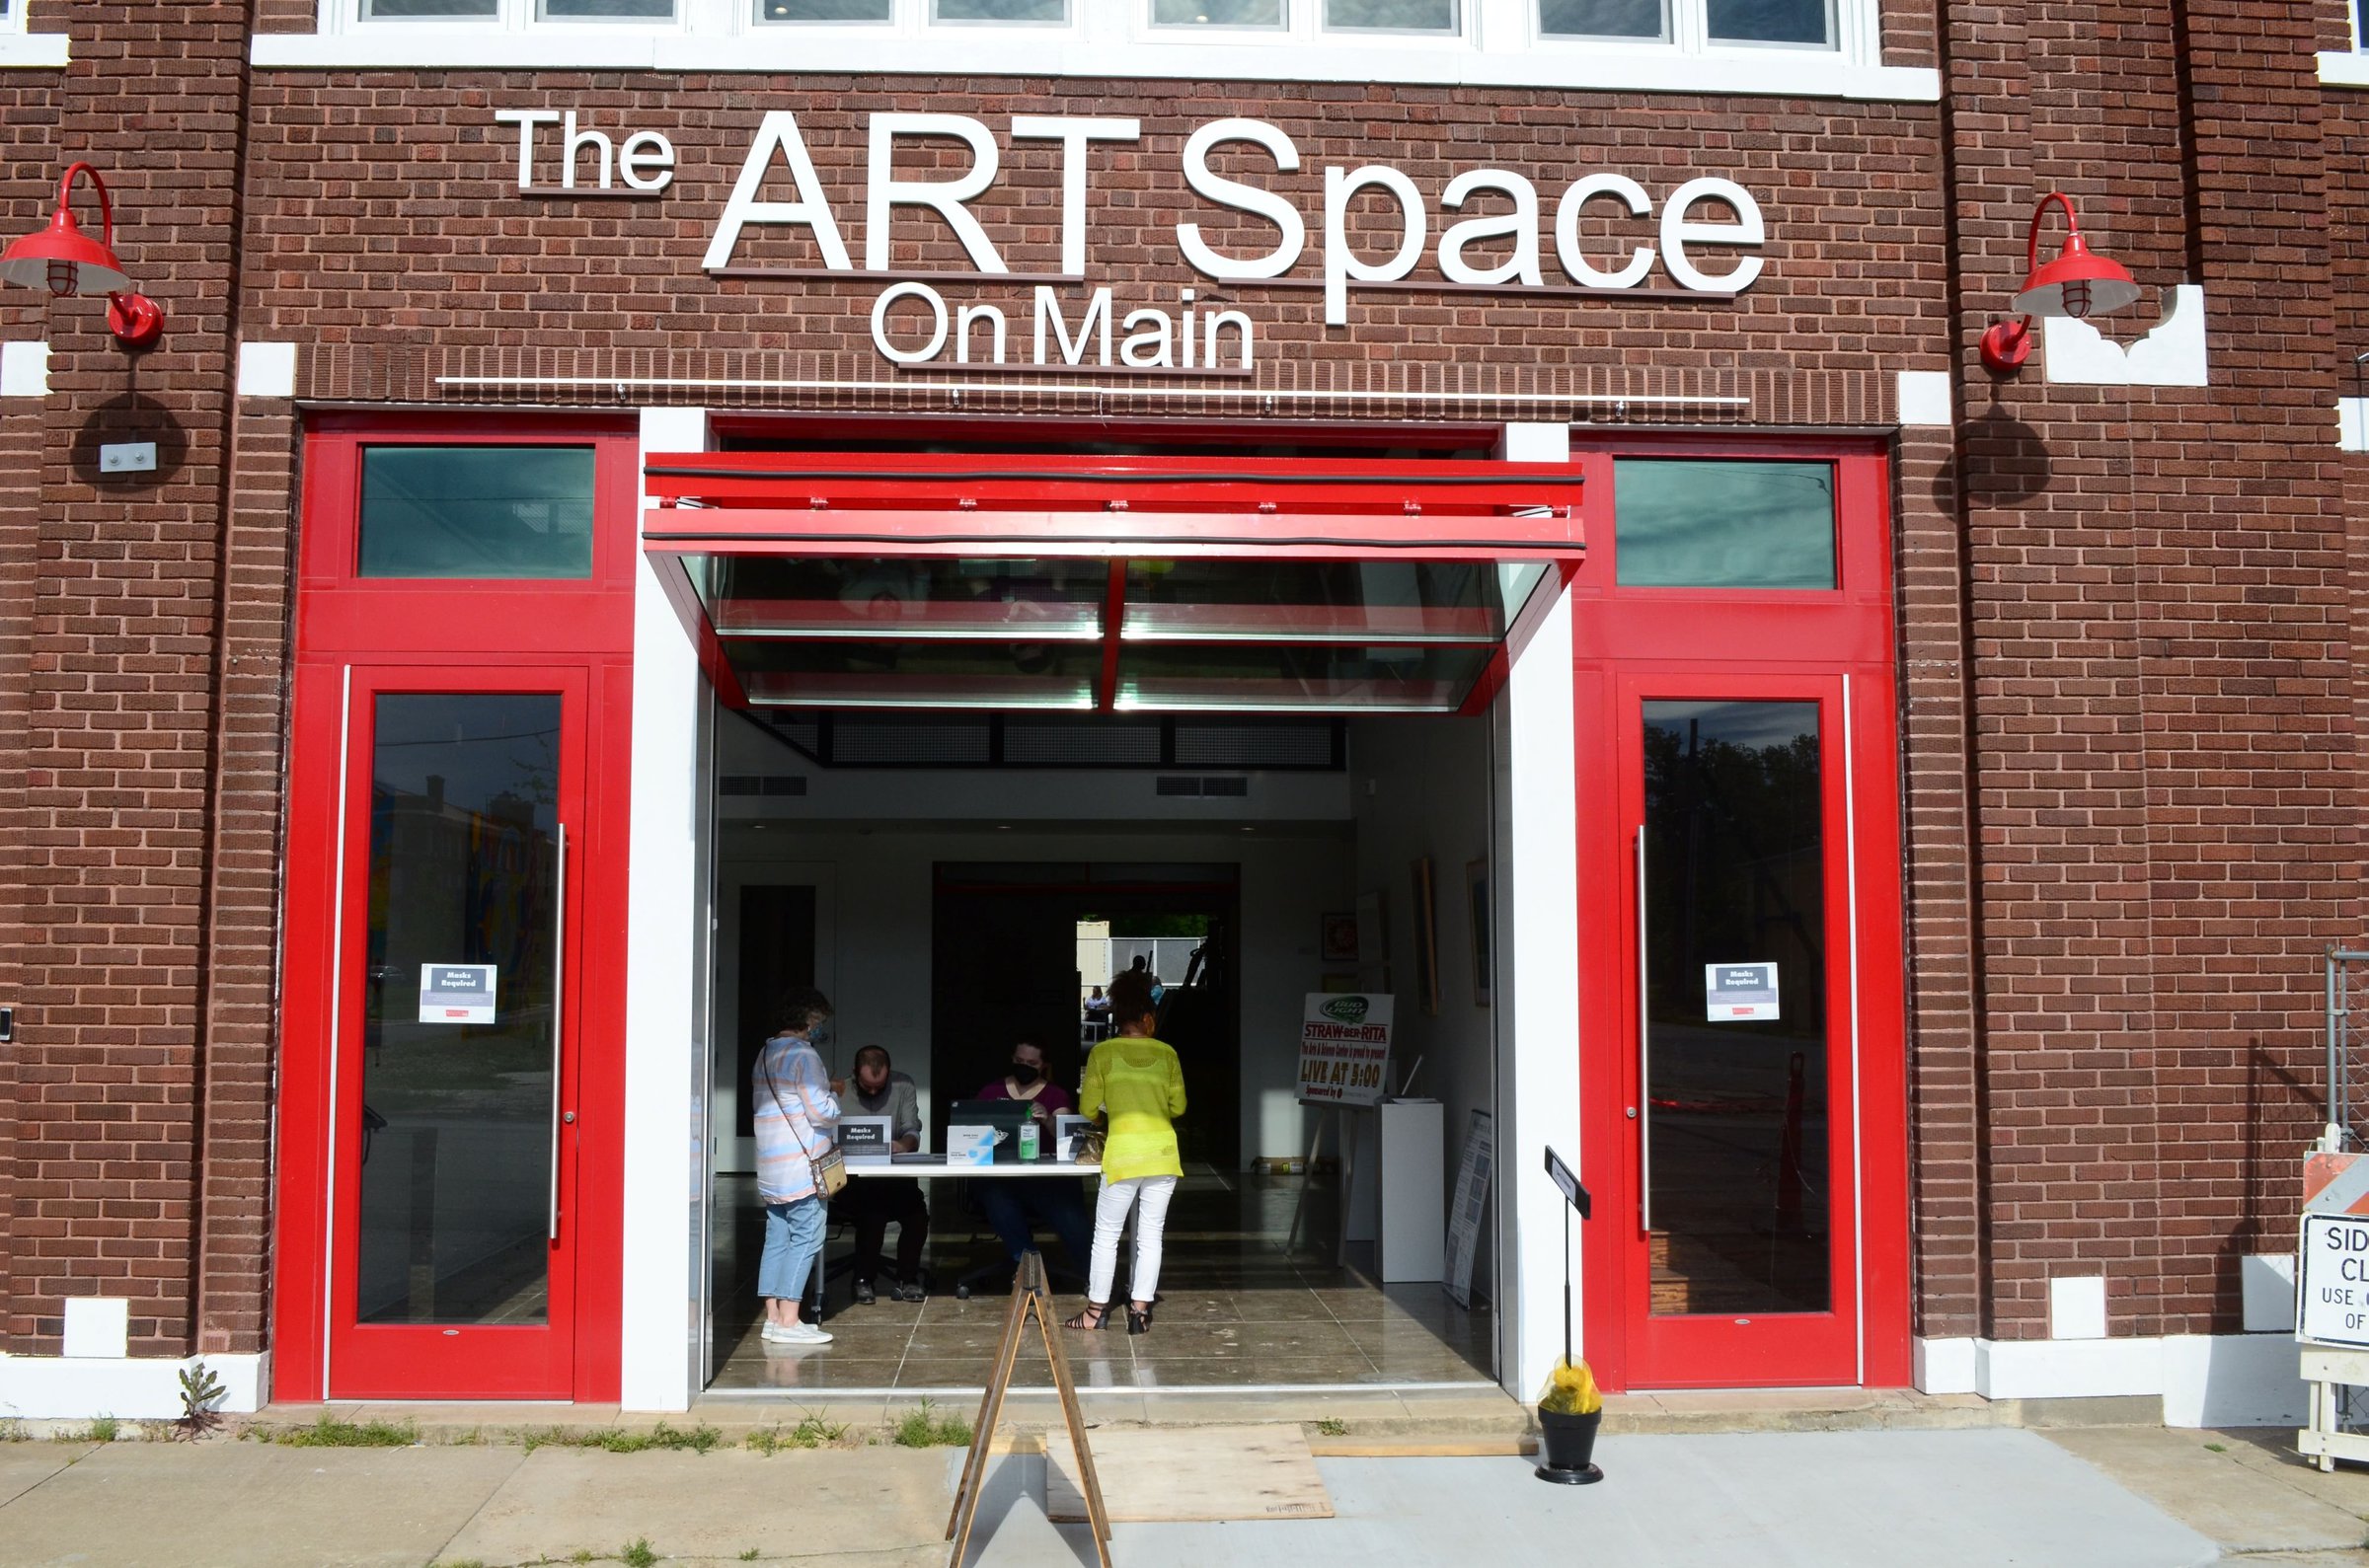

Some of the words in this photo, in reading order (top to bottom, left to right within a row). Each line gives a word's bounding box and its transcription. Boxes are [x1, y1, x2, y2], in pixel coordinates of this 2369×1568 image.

[494, 108, 676, 192] The
[701, 109, 1142, 277] ART
[1175, 115, 1767, 327] Space
[871, 281, 1006, 368] On
[1032, 284, 1256, 376] Main
[441, 979, 476, 988] Required
[1724, 978, 1759, 987] Required
[1304, 1024, 1387, 1041] STRAW-BER-RITA
[1300, 1060, 1329, 1083] LIVE
[1330, 1062, 1349, 1084] AT
[1349, 1063, 1380, 1087] 5:00
[2322, 1287, 2354, 1306] USE
[2345, 1312, 2366, 1330] OF
